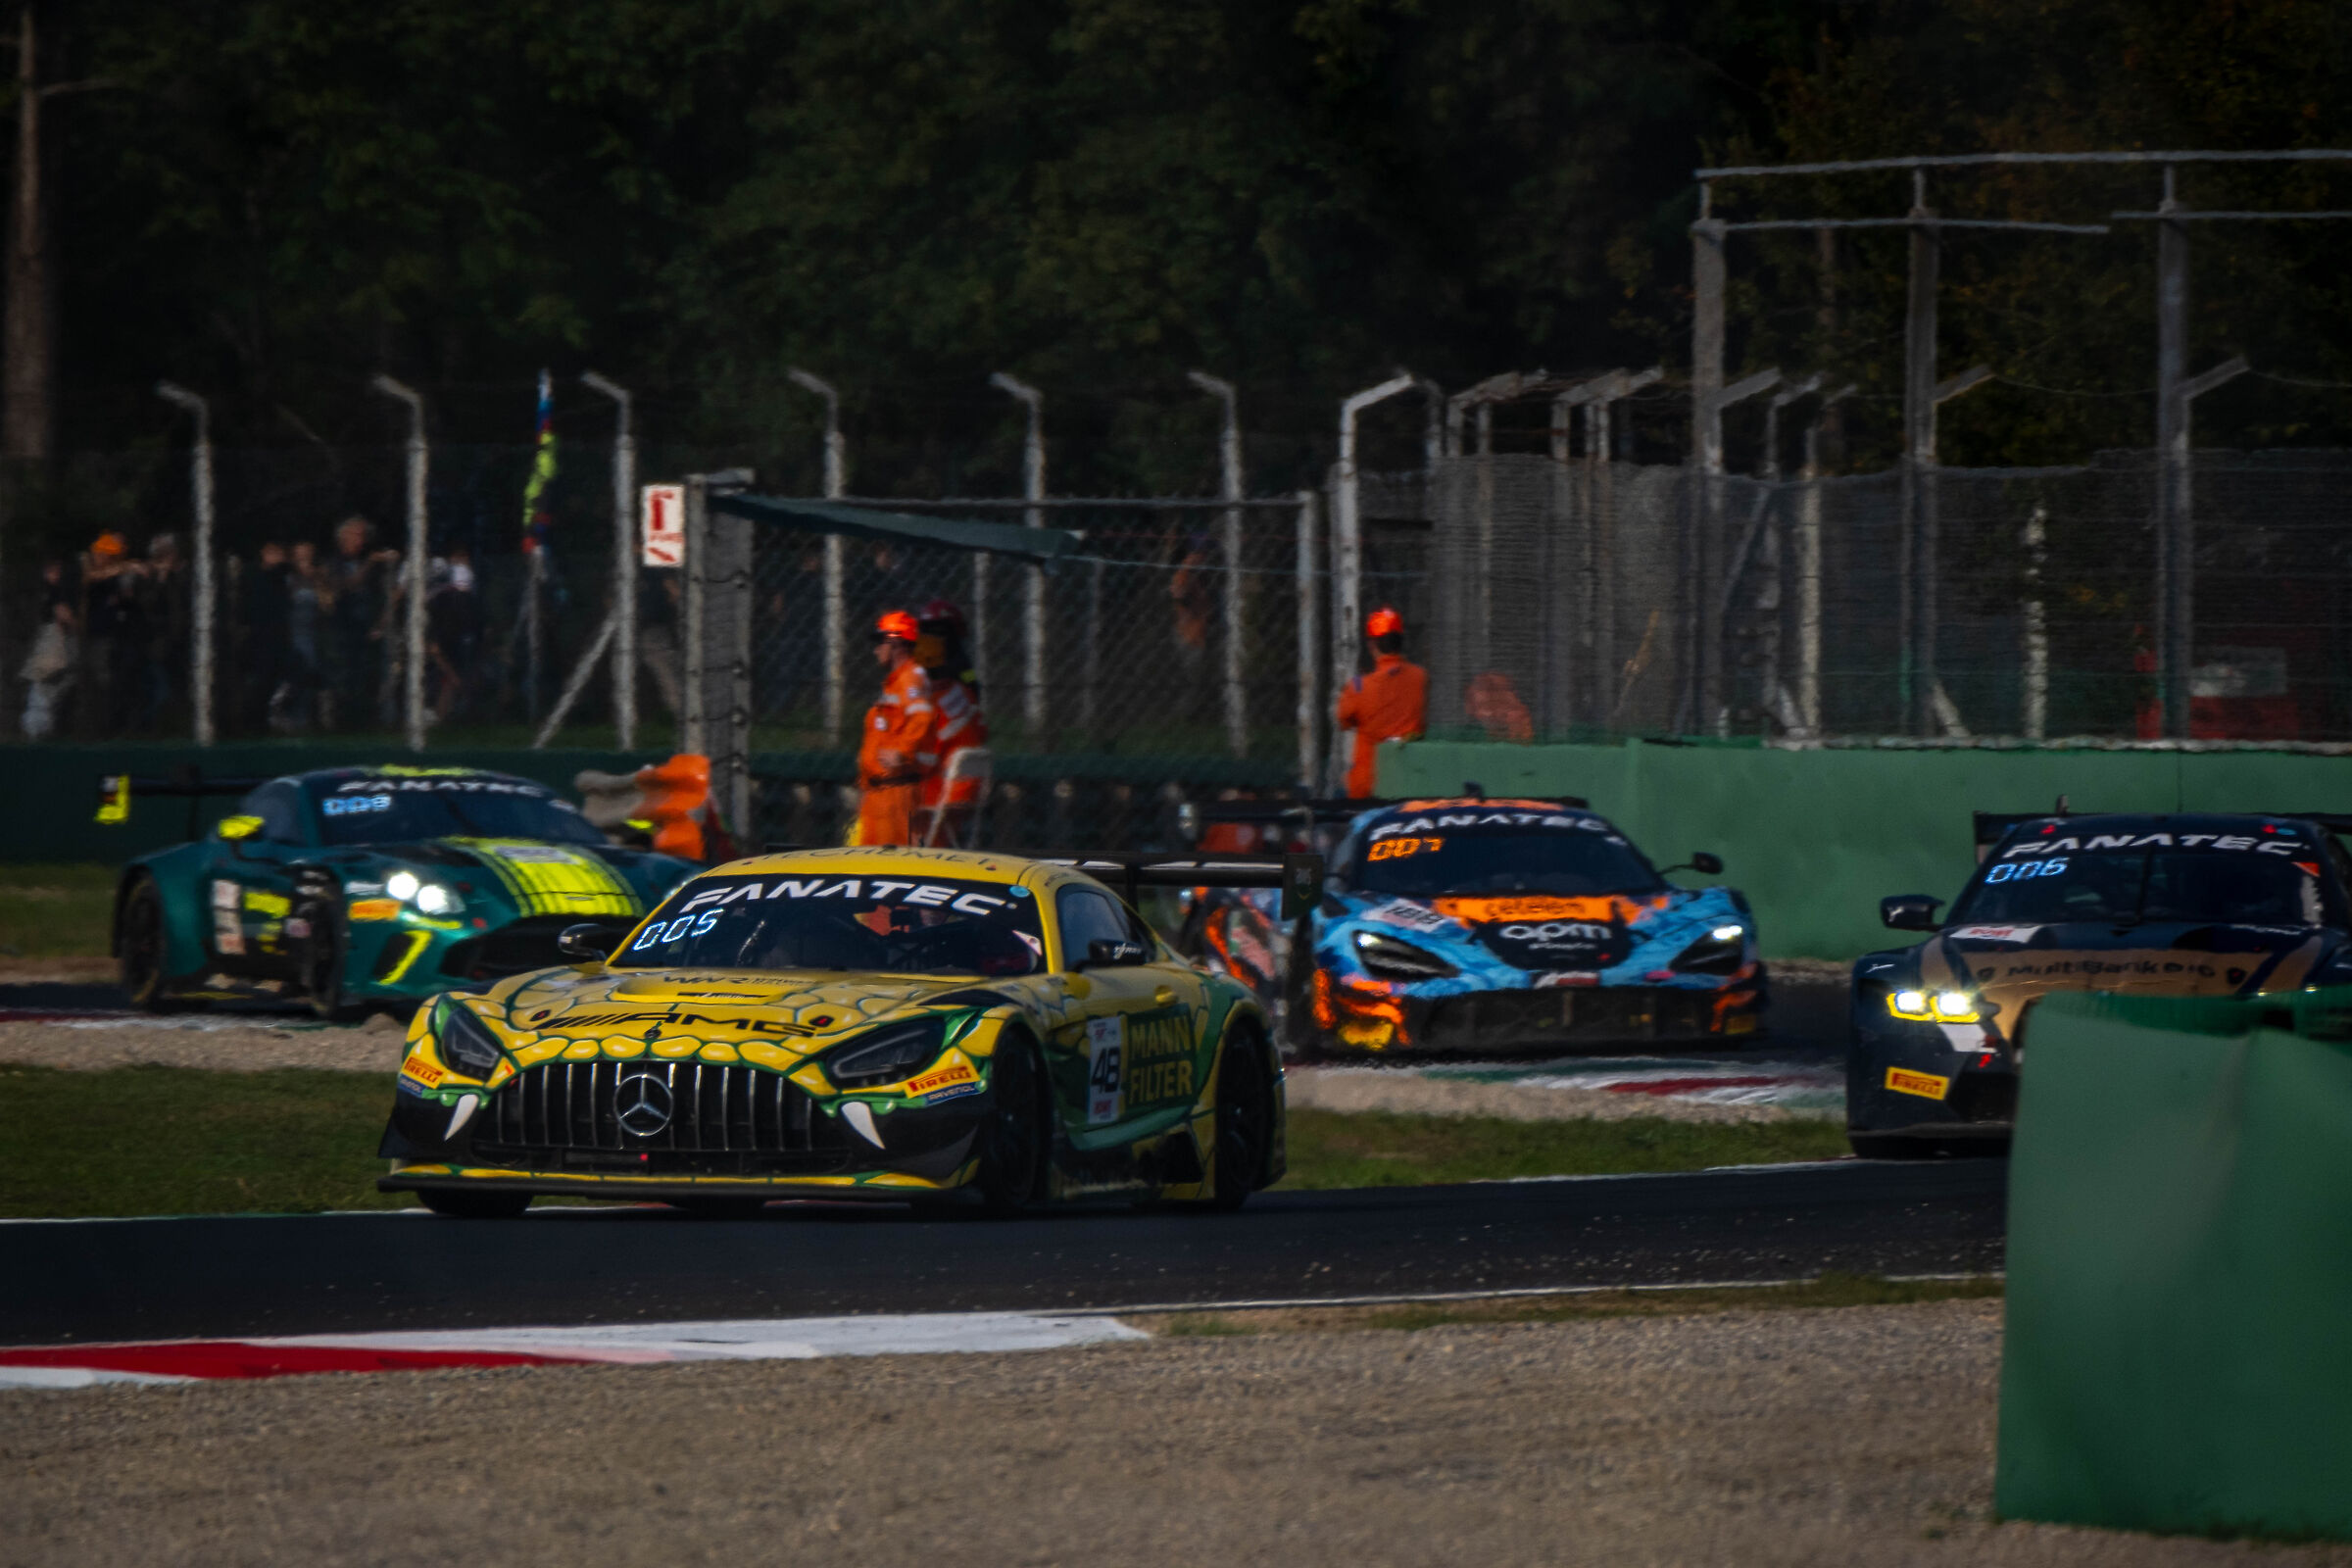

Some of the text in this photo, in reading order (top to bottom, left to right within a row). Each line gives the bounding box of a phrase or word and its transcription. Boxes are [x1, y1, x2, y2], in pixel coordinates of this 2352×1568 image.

[1369, 813, 1609, 841] FANATEC
[2002, 833, 2301, 858] FANATEC
[1984, 857, 2070, 884] 006
[678, 879, 1006, 916] FANATEC
[632, 907, 724, 951] 005
[607, 1011, 816, 1038] AMG
[1130, 1014, 1192, 1061] MANN
[404, 1056, 444, 1084] PIRELLI
[907, 1065, 972, 1093] PIRELLI
[1090, 1047, 1120, 1094] 48
[1129, 1058, 1194, 1105] FILTER
